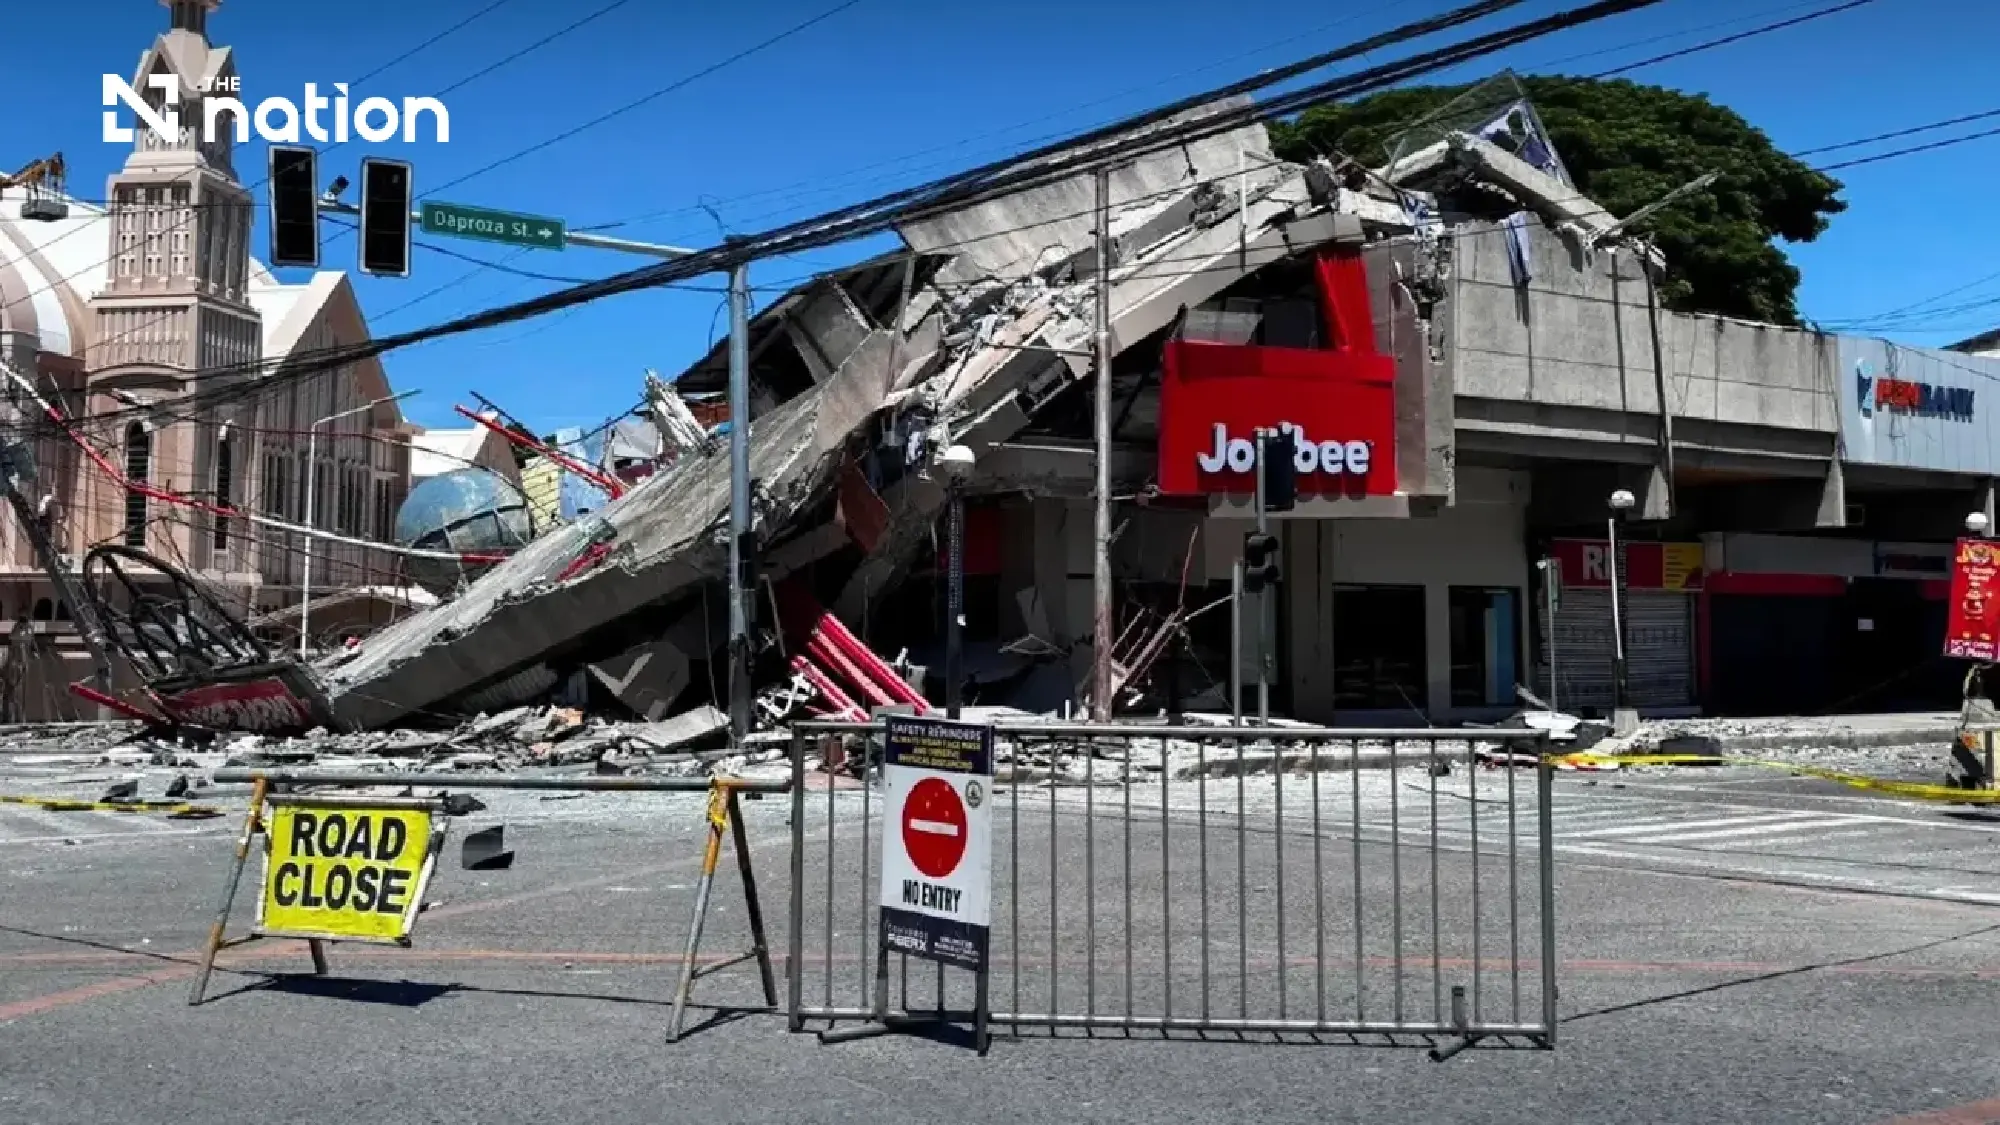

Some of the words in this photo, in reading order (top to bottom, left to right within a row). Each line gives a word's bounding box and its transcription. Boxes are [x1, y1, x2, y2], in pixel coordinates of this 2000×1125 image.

[434, 211, 504, 233] Daproza
[891, 723, 926, 735] SAFETY
[928, 725, 981, 741] REMINDERS
[291, 813, 406, 860] ROAD
[274, 862, 412, 914] CLOSE
[903, 879, 918, 906] NO
[922, 882, 962, 913] ENTRY
